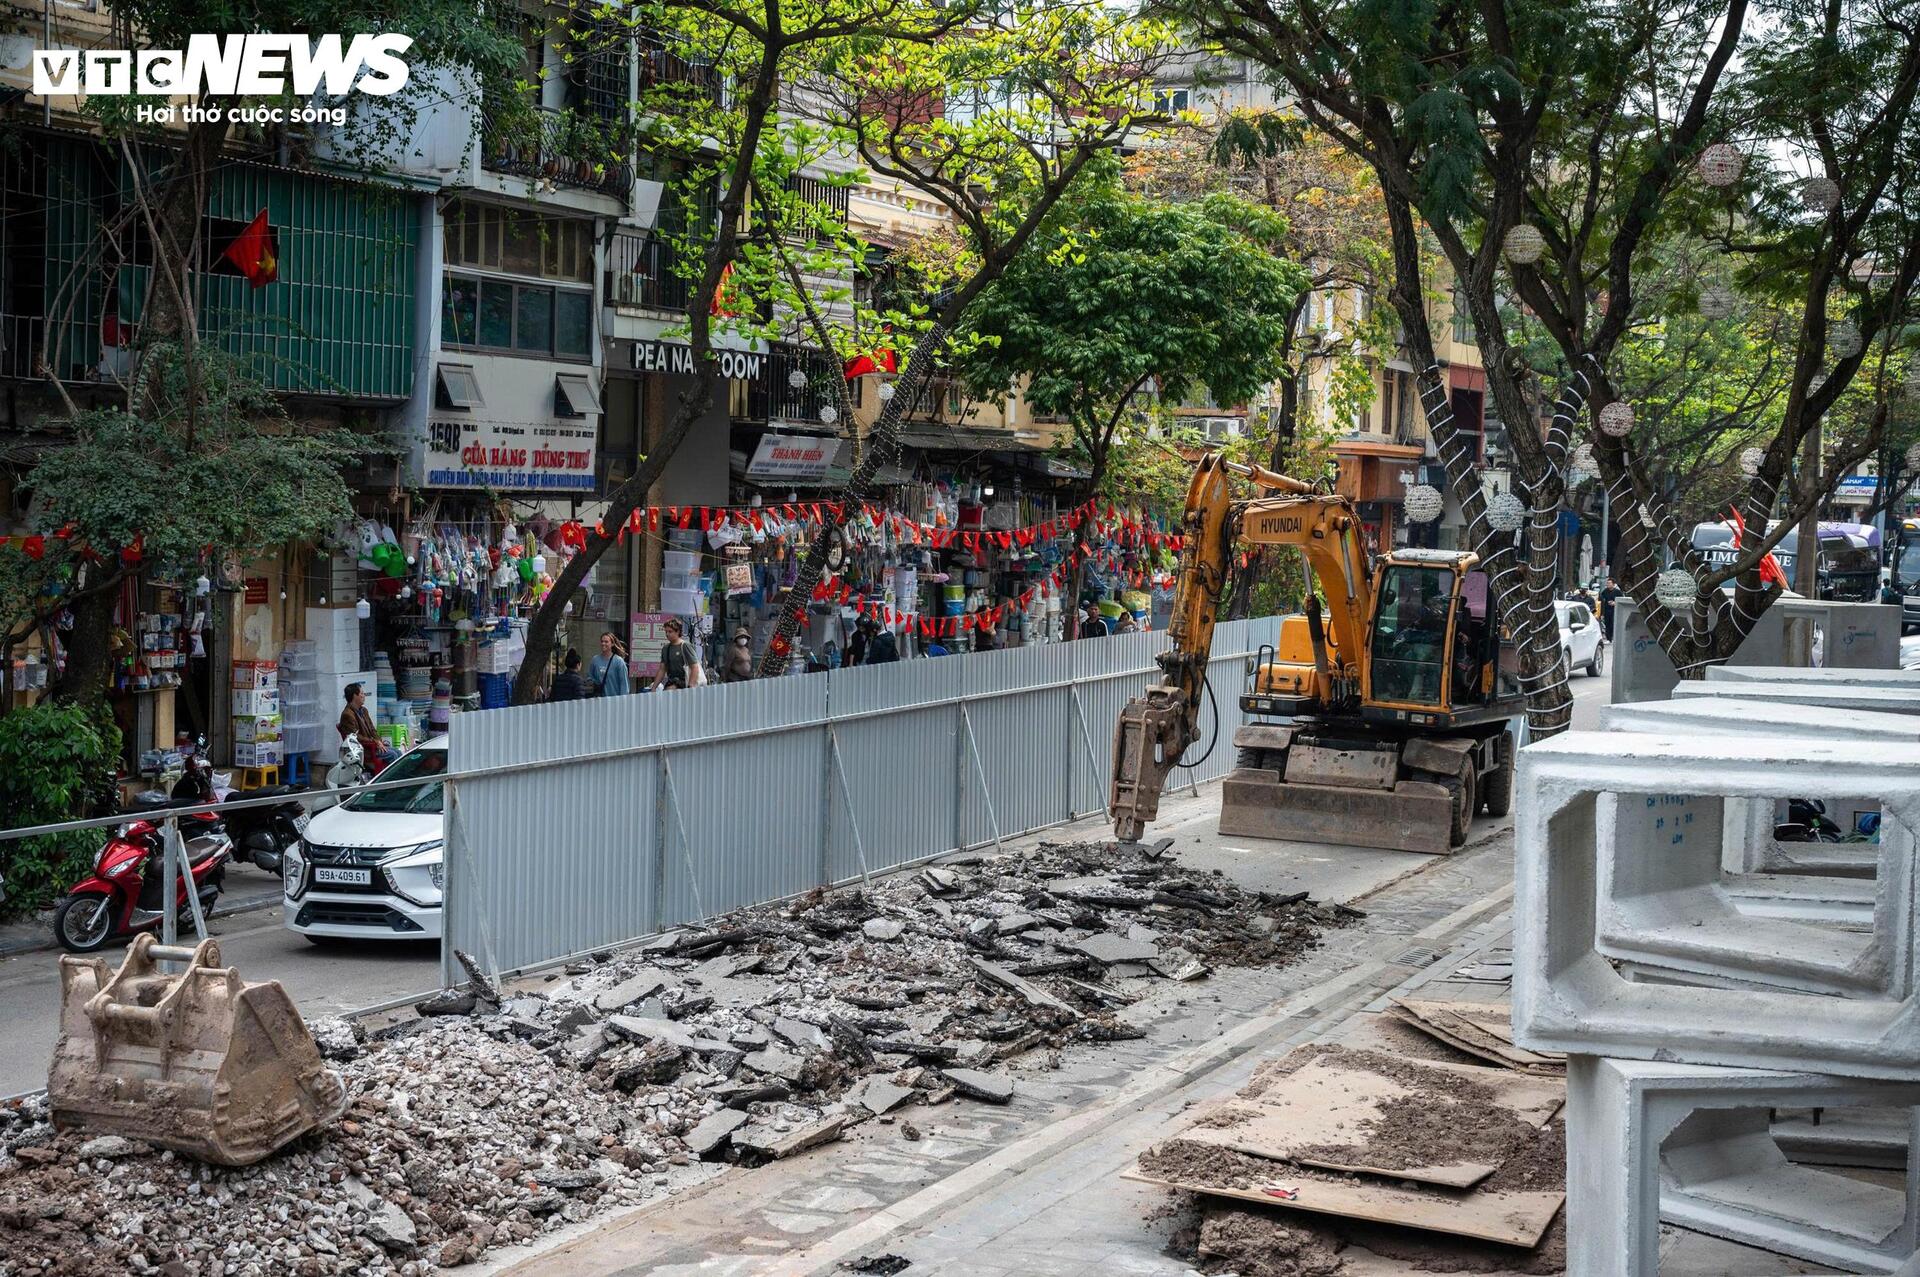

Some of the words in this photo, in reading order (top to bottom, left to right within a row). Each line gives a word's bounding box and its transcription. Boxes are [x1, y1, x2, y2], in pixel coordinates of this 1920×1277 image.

[635, 342, 667, 371] PEA
[672, 346, 698, 375] NA
[462, 440, 488, 465] CỬA
[489, 440, 528, 466] HÀNG
[1261, 517, 1302, 534] HYUNDAI
[319, 870, 366, 882] 99A-409.61
